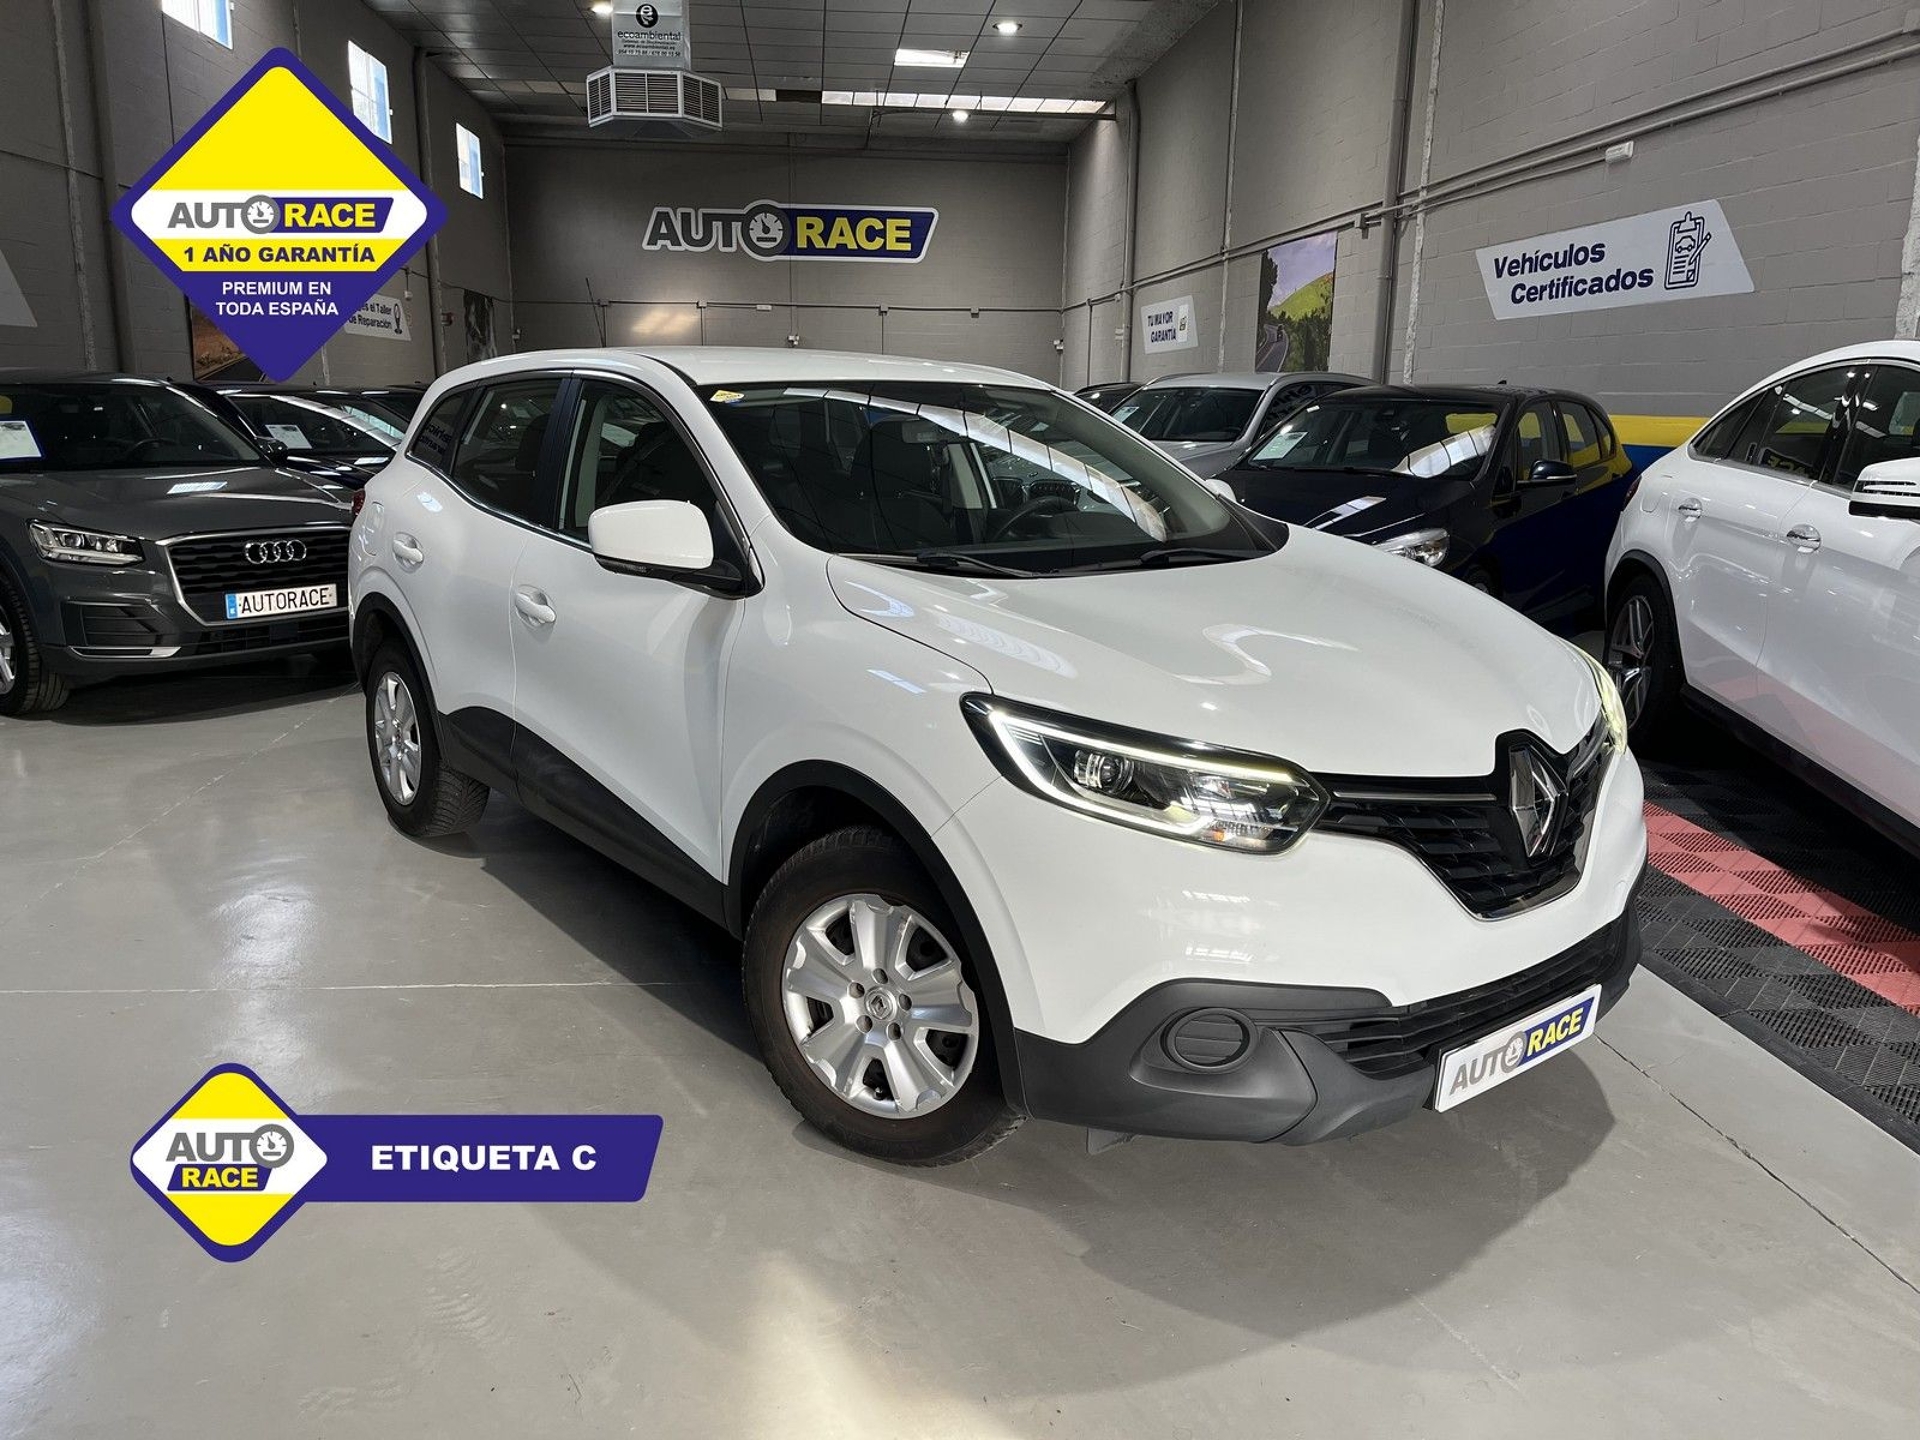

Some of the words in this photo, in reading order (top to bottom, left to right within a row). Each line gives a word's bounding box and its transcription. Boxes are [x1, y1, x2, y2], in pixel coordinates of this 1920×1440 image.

[617, 30, 681, 41] ecoambiental
[796, 216, 911, 251] RACE
[1494, 243, 1606, 279] Vehículos
[1511, 268, 1654, 305] Certificados
[358, 314, 392, 329] Reparación
[377, 303, 391, 315] Taller
[242, 588, 329, 614] AUTORACE
[1527, 1008, 1583, 1057] RACE
